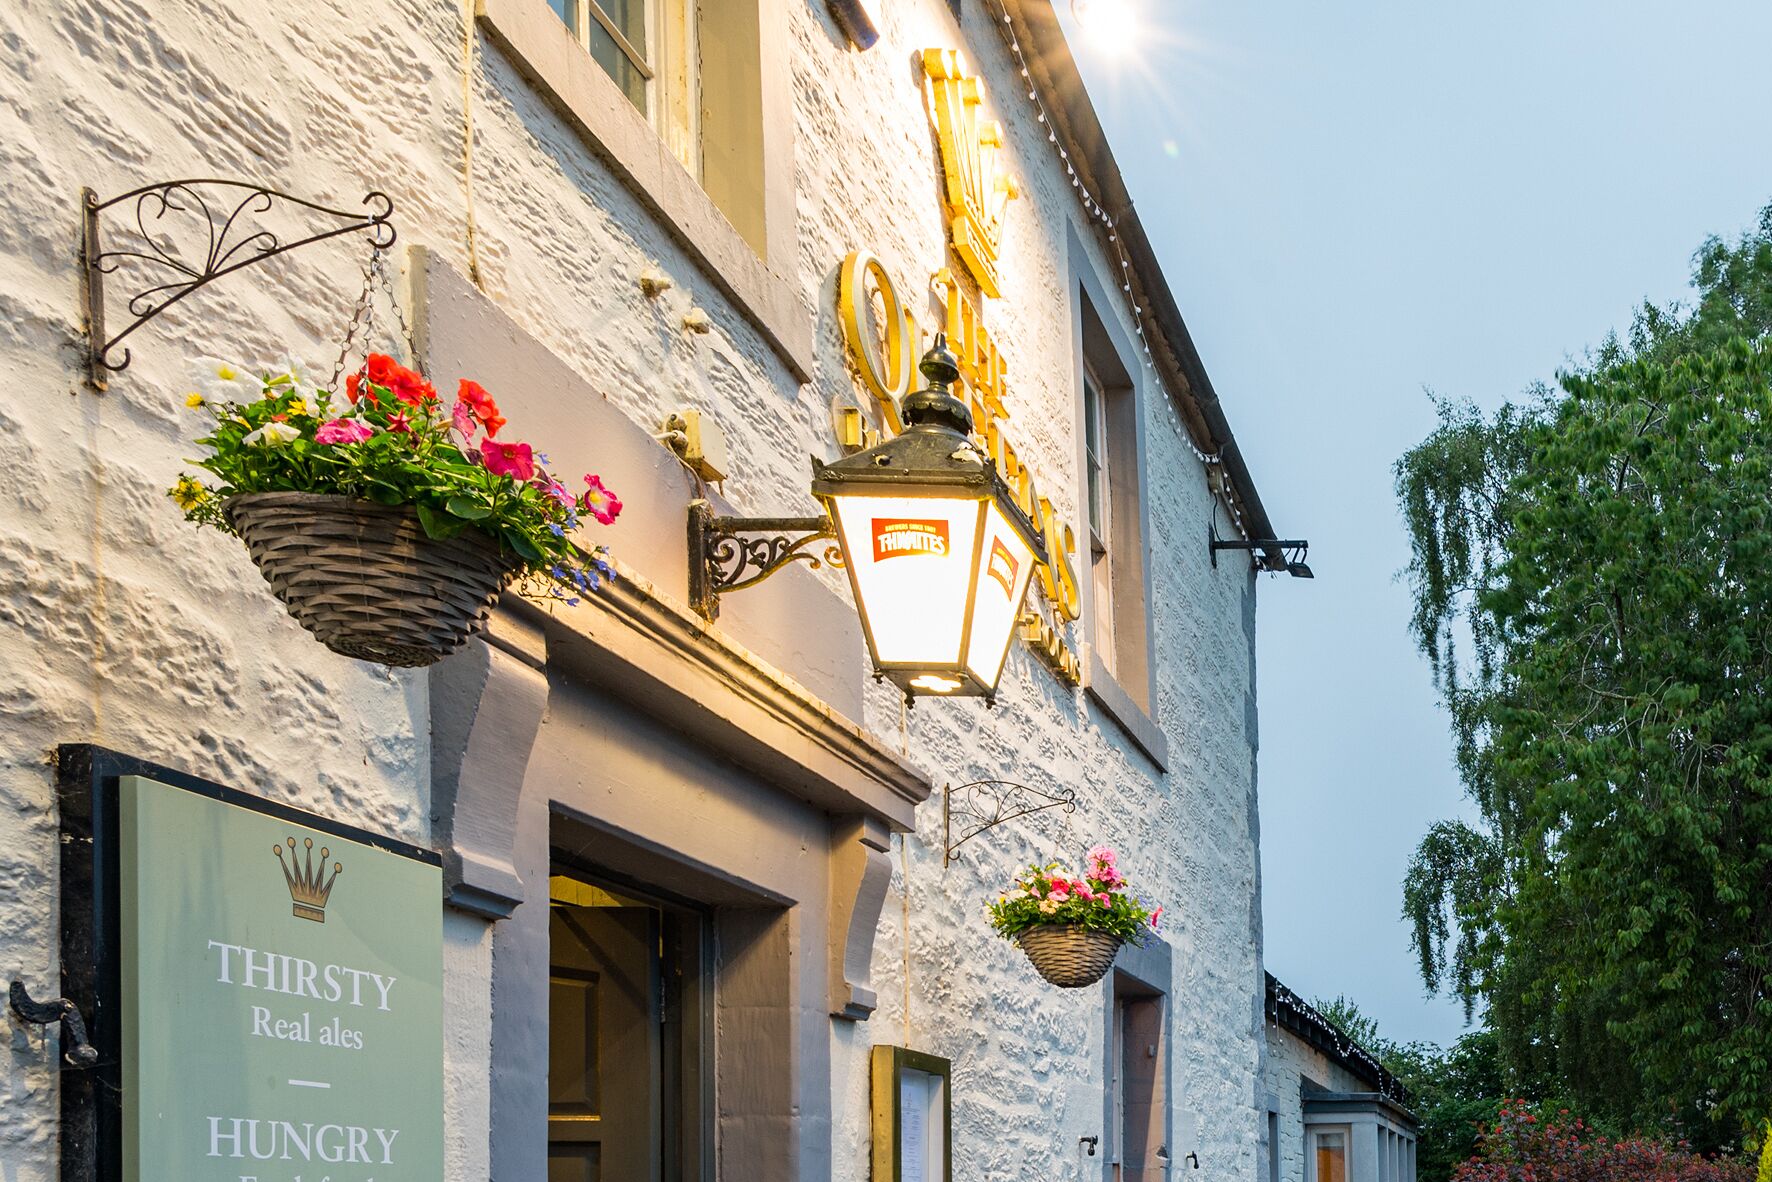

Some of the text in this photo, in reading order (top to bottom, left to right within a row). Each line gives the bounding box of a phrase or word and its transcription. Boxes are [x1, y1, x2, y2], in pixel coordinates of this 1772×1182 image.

[877, 530, 946, 555] THWAITES
[207, 939, 398, 1012] THIRSTY
[250, 1005, 364, 1050] Real ales
[206, 1116, 400, 1165] HUNGRY
